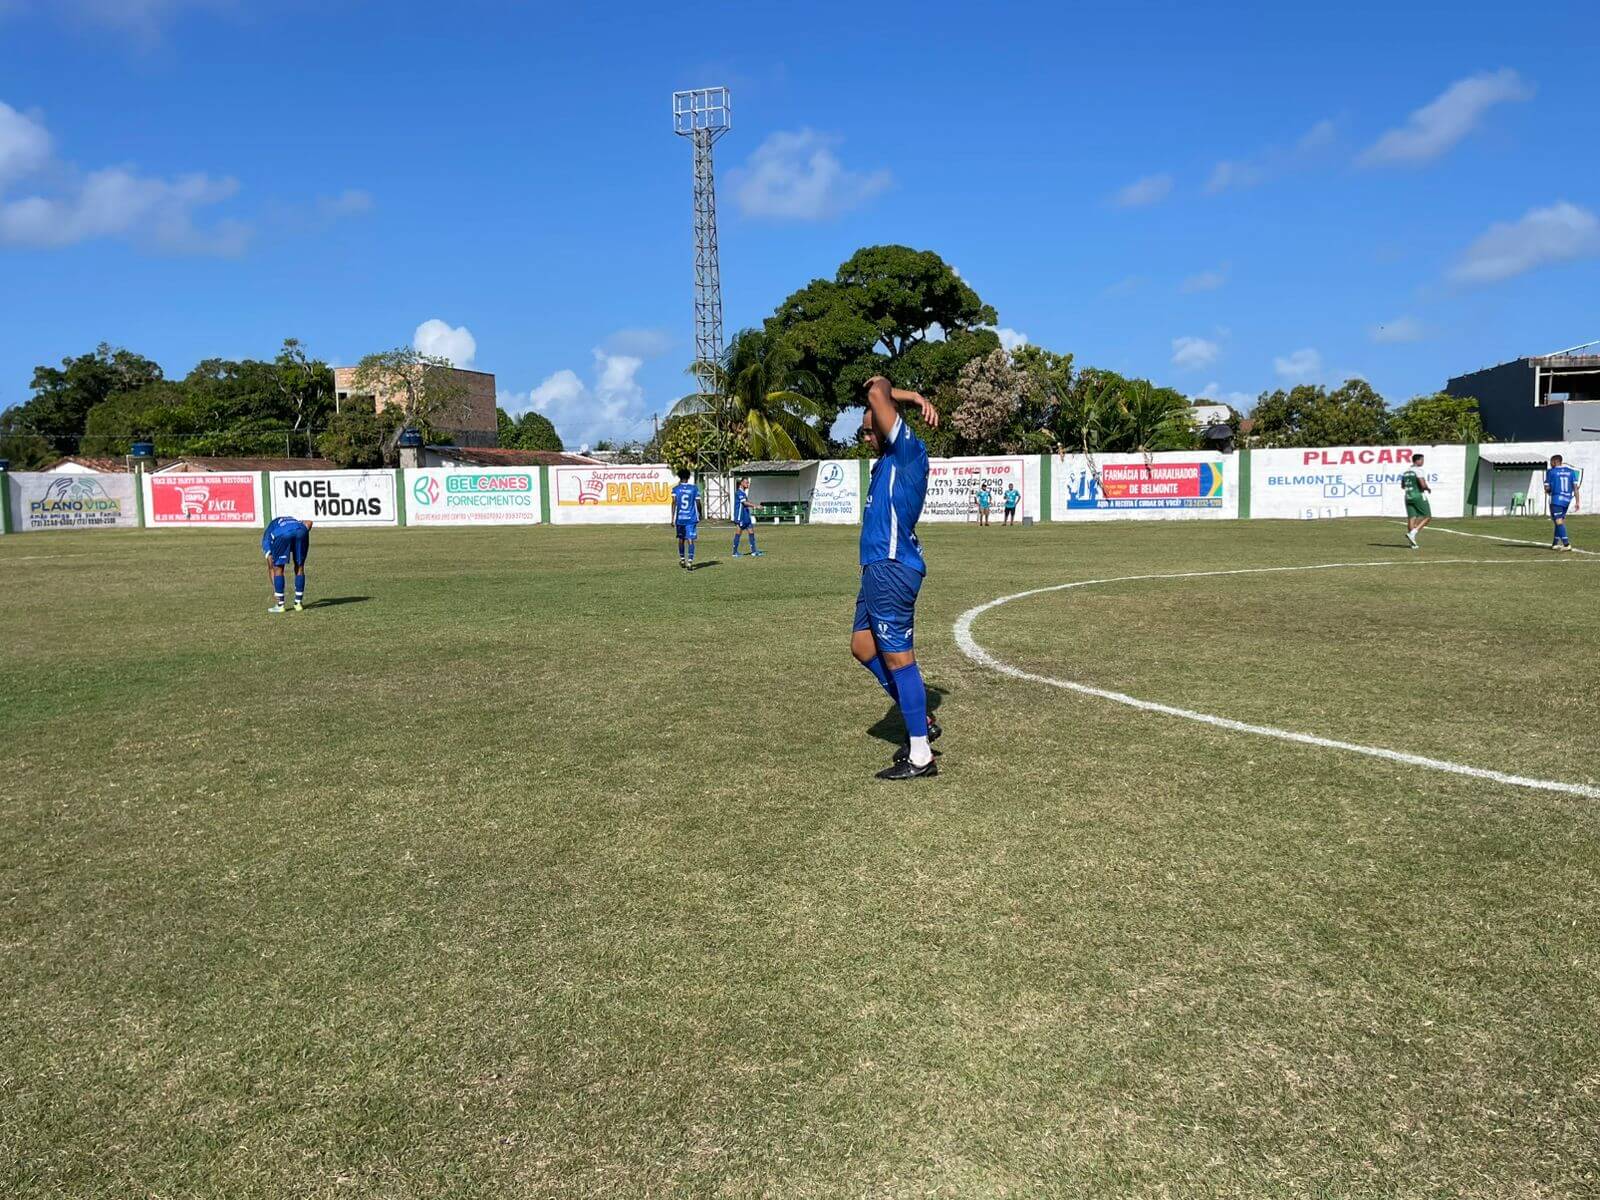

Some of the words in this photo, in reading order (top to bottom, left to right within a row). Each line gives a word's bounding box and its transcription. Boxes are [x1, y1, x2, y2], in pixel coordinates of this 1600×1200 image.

[1303, 448, 1413, 465] PLACAR
[592, 471, 660, 482] Supermercado
[986, 466, 1010, 475] TUDO
[450, 477, 528, 490] BELCANES
[1268, 475, 1343, 485] BELMONTE
[1366, 473, 1439, 483] EUNAIS
[1560, 477, 1569, 492] 11
[284, 480, 340, 498] NOEL
[606, 482, 670, 503] PAPAU
[31, 501, 83, 512] PLANO
[85, 500, 118, 511] VIDA
[208, 498, 236, 512] FÁCIL
[314, 497, 381, 516] MODAS
[446, 495, 531, 507] FORNECIMENTOS
